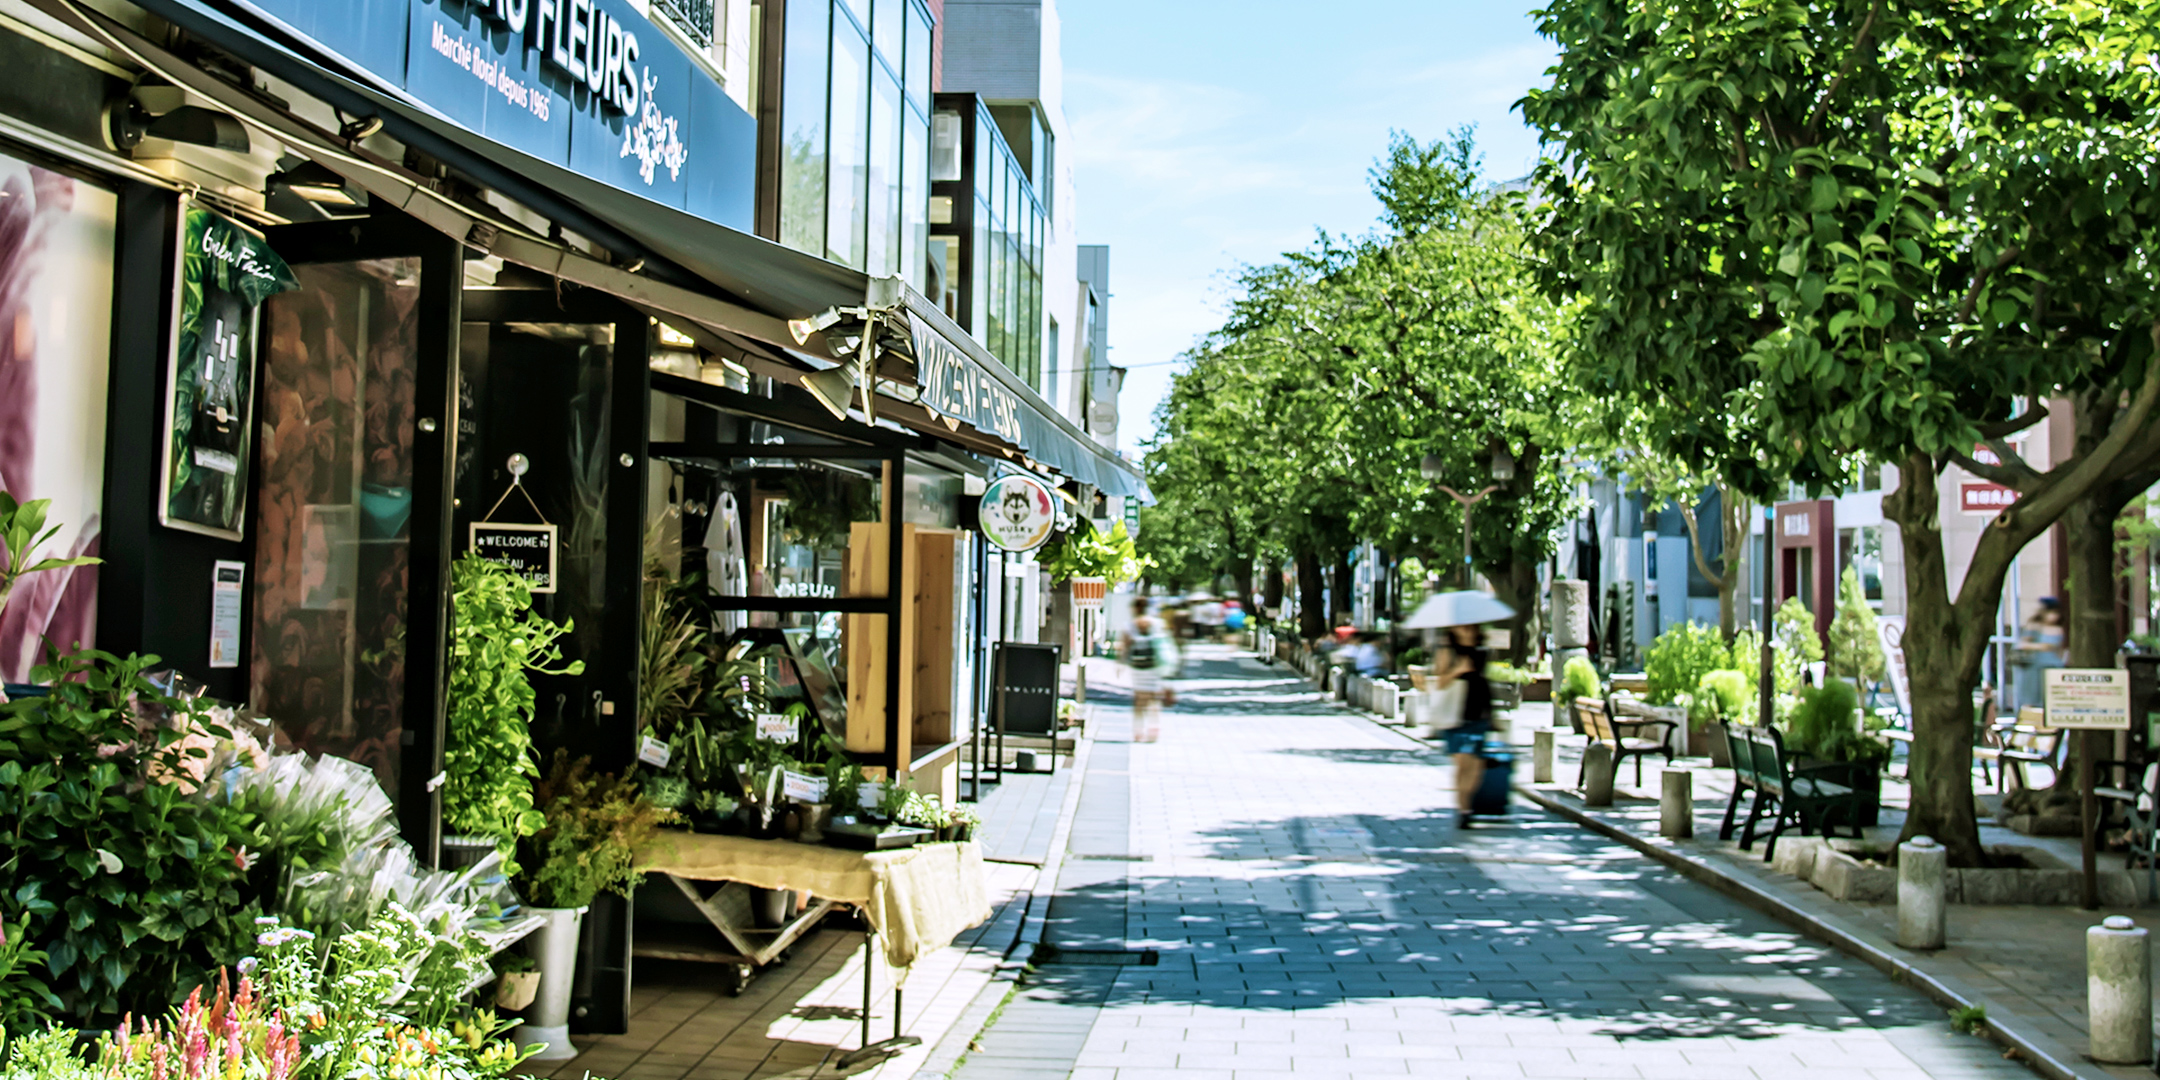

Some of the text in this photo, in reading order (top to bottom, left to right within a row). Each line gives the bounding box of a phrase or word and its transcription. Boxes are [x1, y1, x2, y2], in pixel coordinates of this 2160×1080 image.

[431, 20, 549, 122] Marché floral depuis 1965
[536, 0, 640, 117] FLEURS
[486, 535, 538, 548] WELCOME
